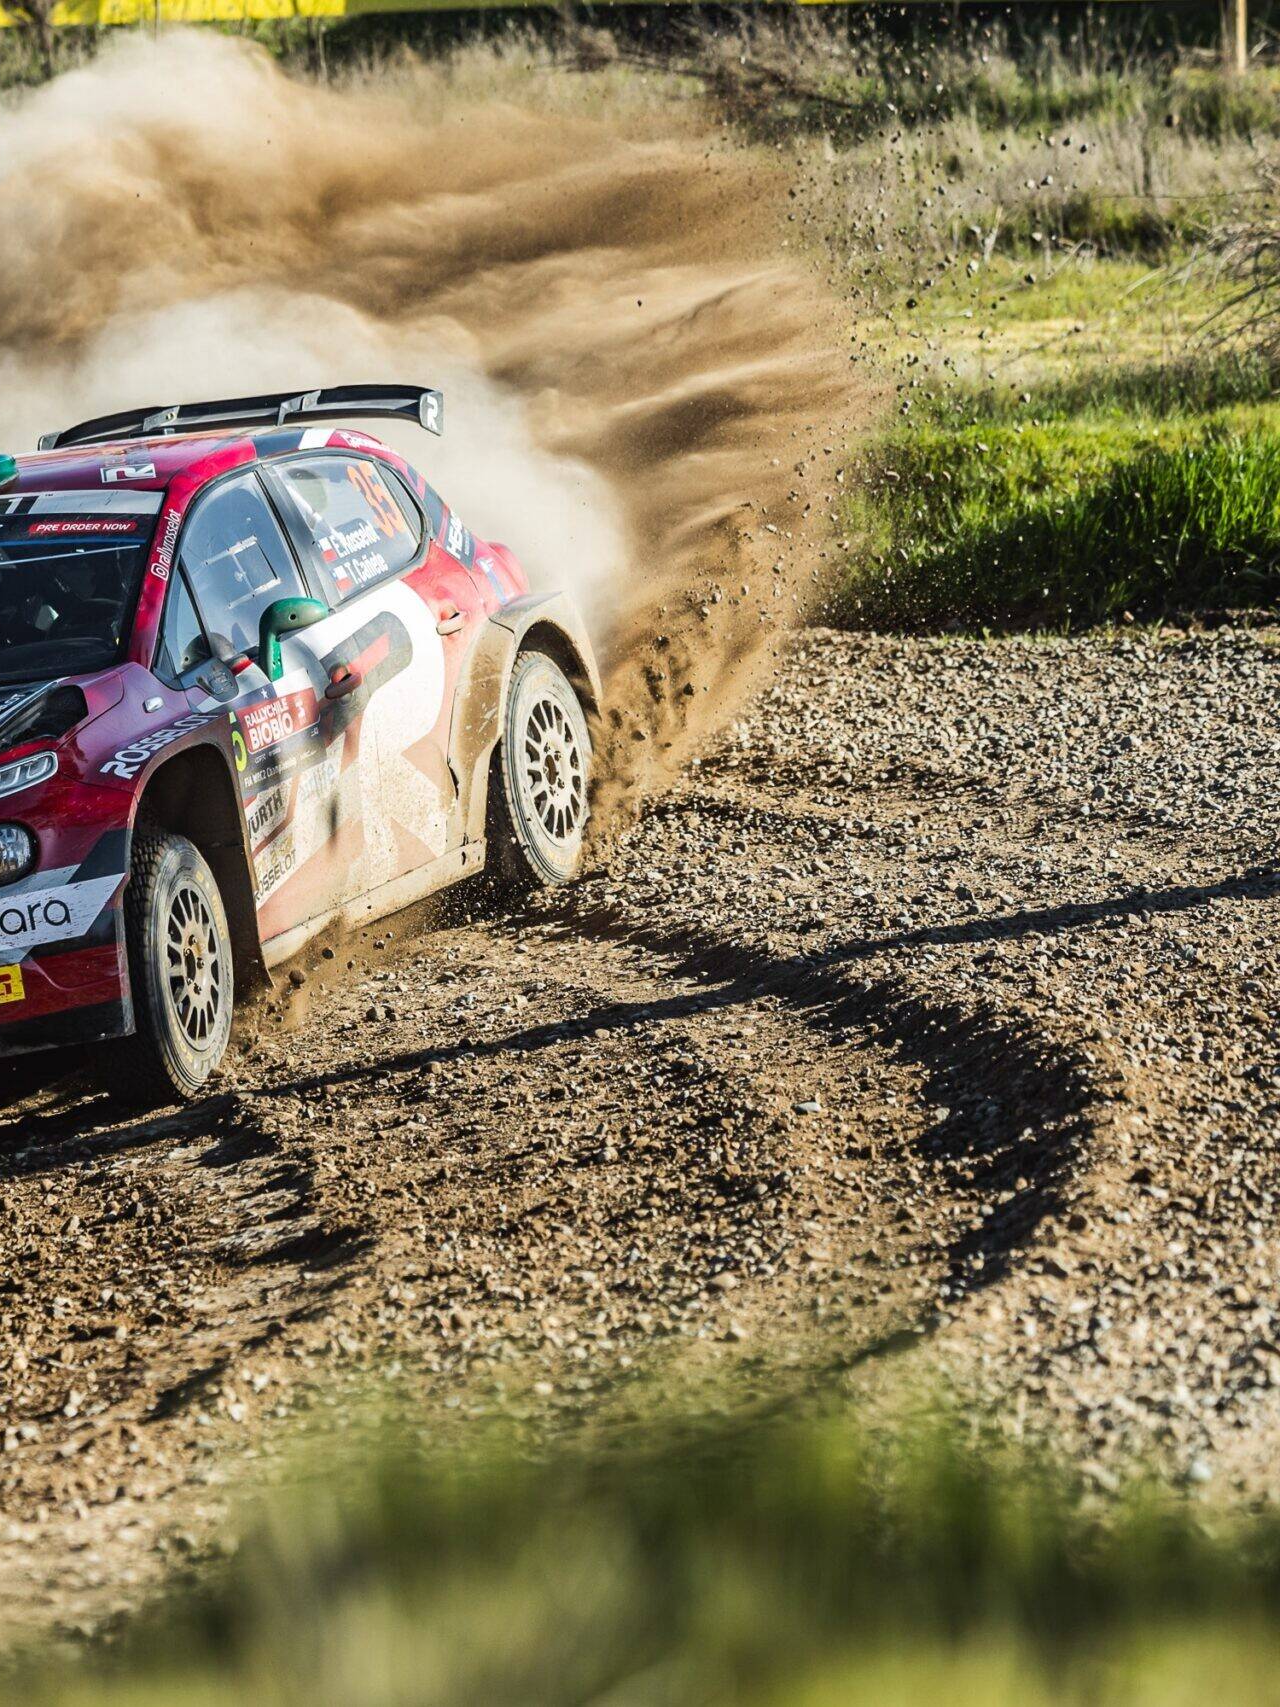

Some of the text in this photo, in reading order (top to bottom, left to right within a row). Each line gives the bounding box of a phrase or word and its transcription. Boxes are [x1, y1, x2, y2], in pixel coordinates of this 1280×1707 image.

[347, 460, 407, 539] 35
[36, 523, 131, 532] PRE ORDER NOW
[100, 714, 219, 780] ROSSELOT
[248, 712, 294, 751] BIOBIO
